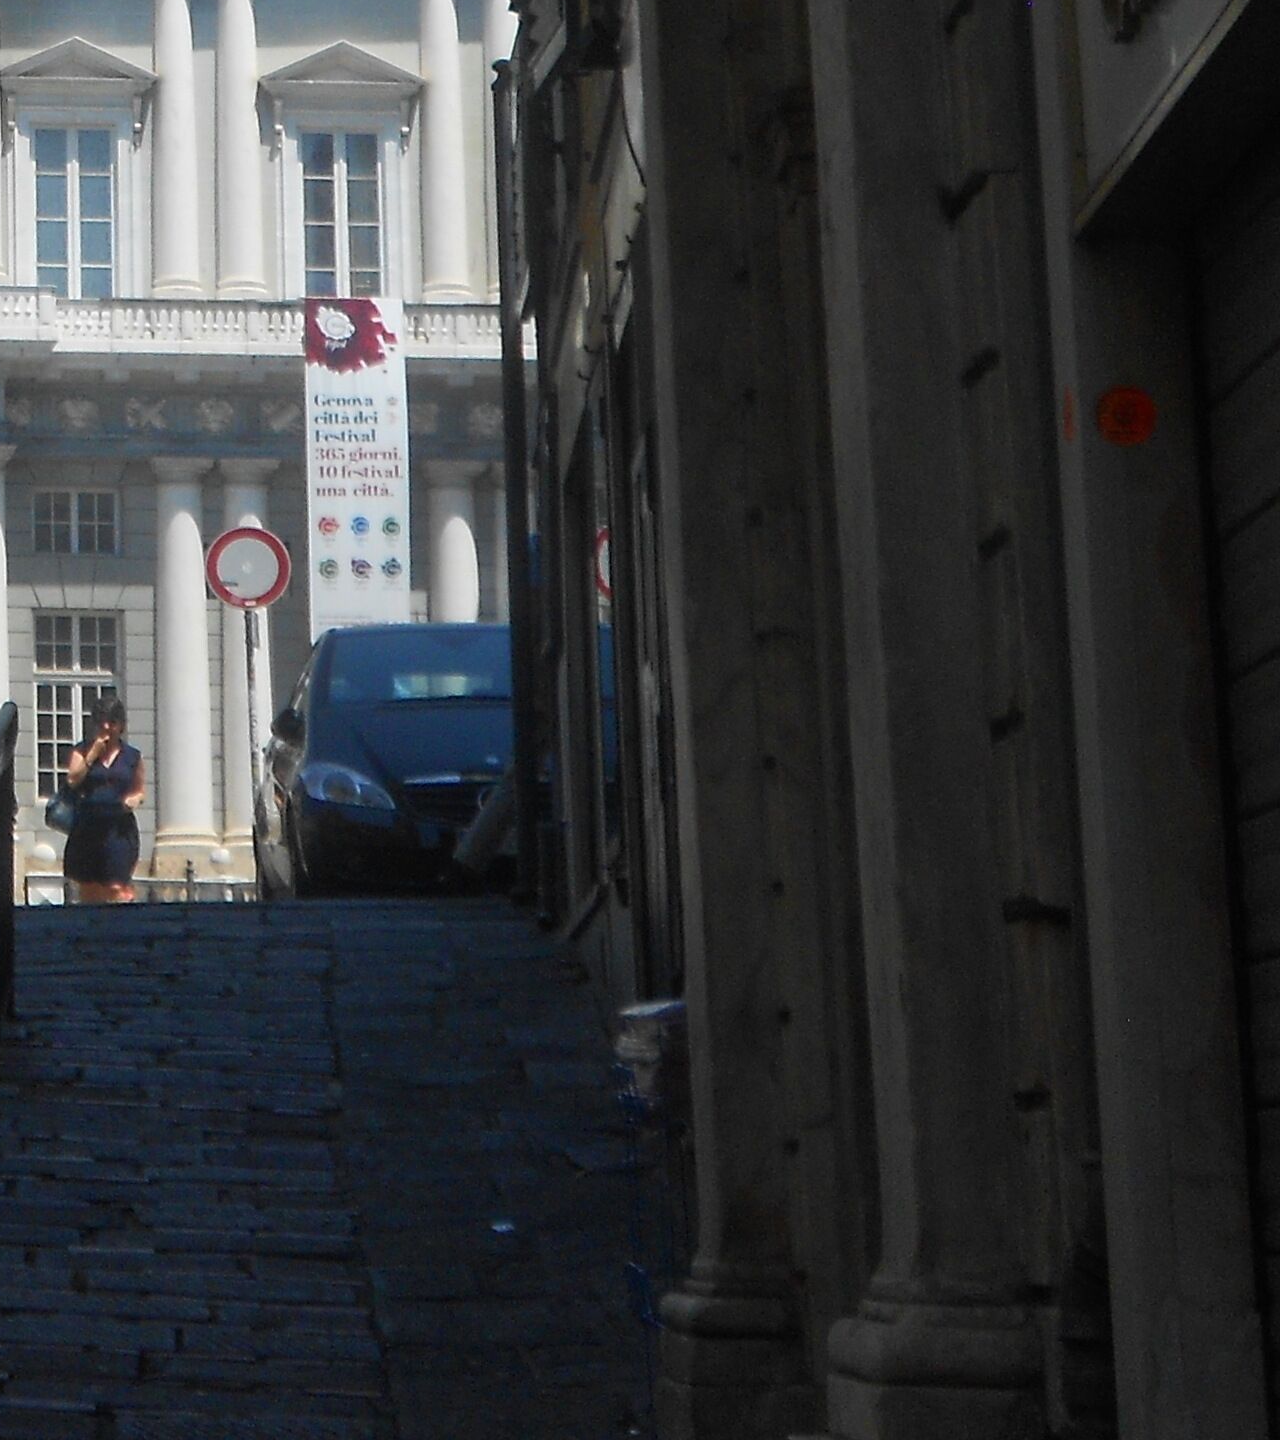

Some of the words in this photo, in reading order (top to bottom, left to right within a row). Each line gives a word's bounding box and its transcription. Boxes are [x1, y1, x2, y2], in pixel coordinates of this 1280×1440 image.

[313, 393, 374, 407] Genova
[313, 411, 350, 425] città
[353, 410, 379, 425] dei
[314, 428, 377, 443] Festival
[314, 447, 346, 461] 365
[318, 465, 338, 479] 10
[316, 487, 347, 497] una
